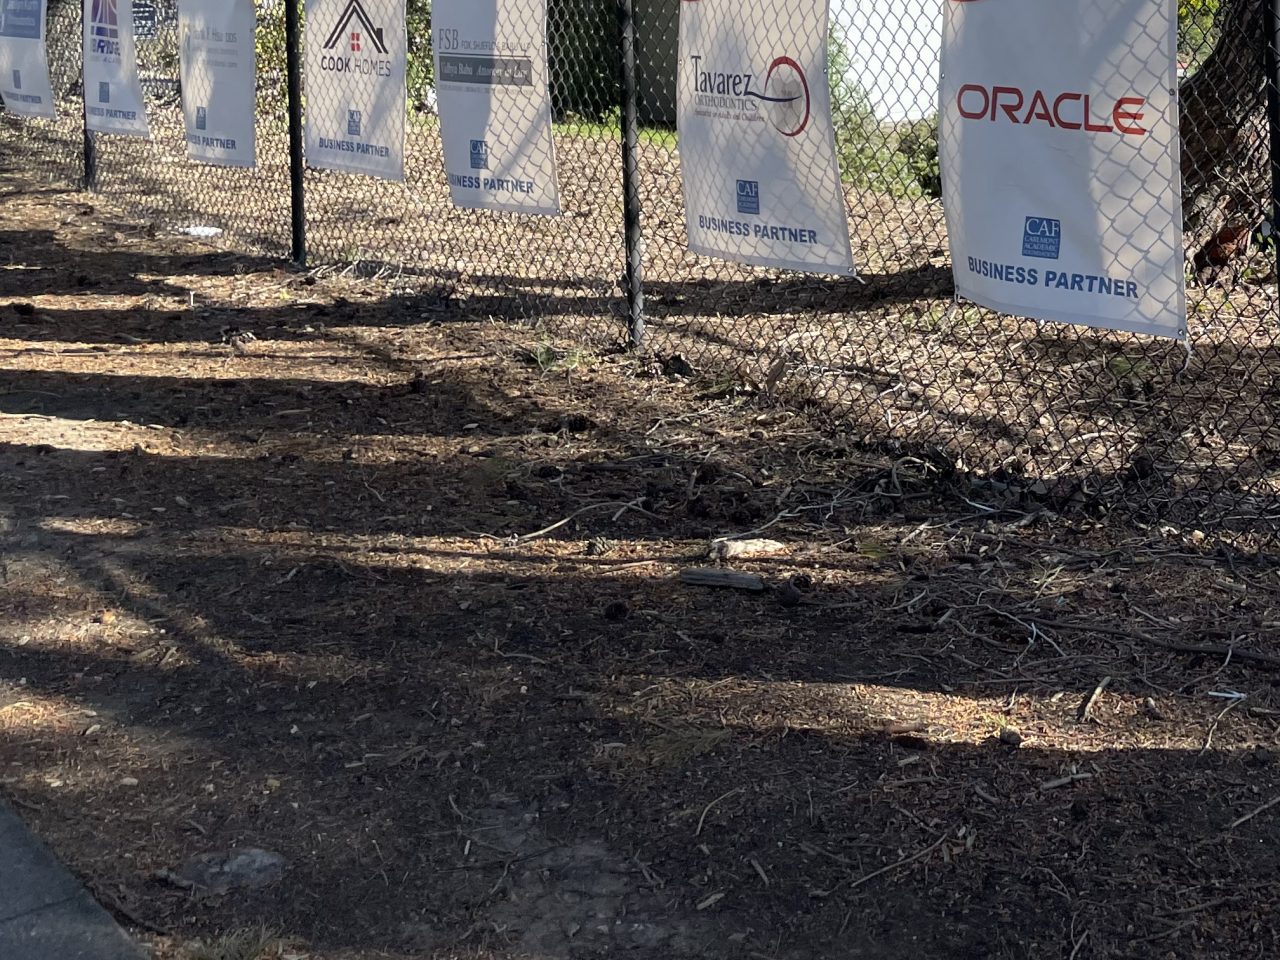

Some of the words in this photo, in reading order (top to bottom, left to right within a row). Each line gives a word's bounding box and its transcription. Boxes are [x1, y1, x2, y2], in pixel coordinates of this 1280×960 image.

[439, 28, 459, 50] FSB
[321, 56, 351, 73] COOK
[354, 59, 391, 77] HOMES
[691, 55, 752, 96] Tavarez
[105, 108, 137, 120] PARTNER
[957, 84, 1147, 135] ORACLE
[202, 136, 237, 150] PARTNER
[319, 137, 354, 152] BUSINESS
[356, 143, 389, 157] PARTNER
[483, 178, 534, 194] PARTNER
[737, 181, 758, 196] CAF
[699, 215, 750, 237] BUSINESS
[754, 224, 817, 244] PARTNER
[1026, 218, 1060, 237] CAF
[968, 256, 1038, 285] BUSINESS
[1045, 271, 1139, 298] PARTNER
